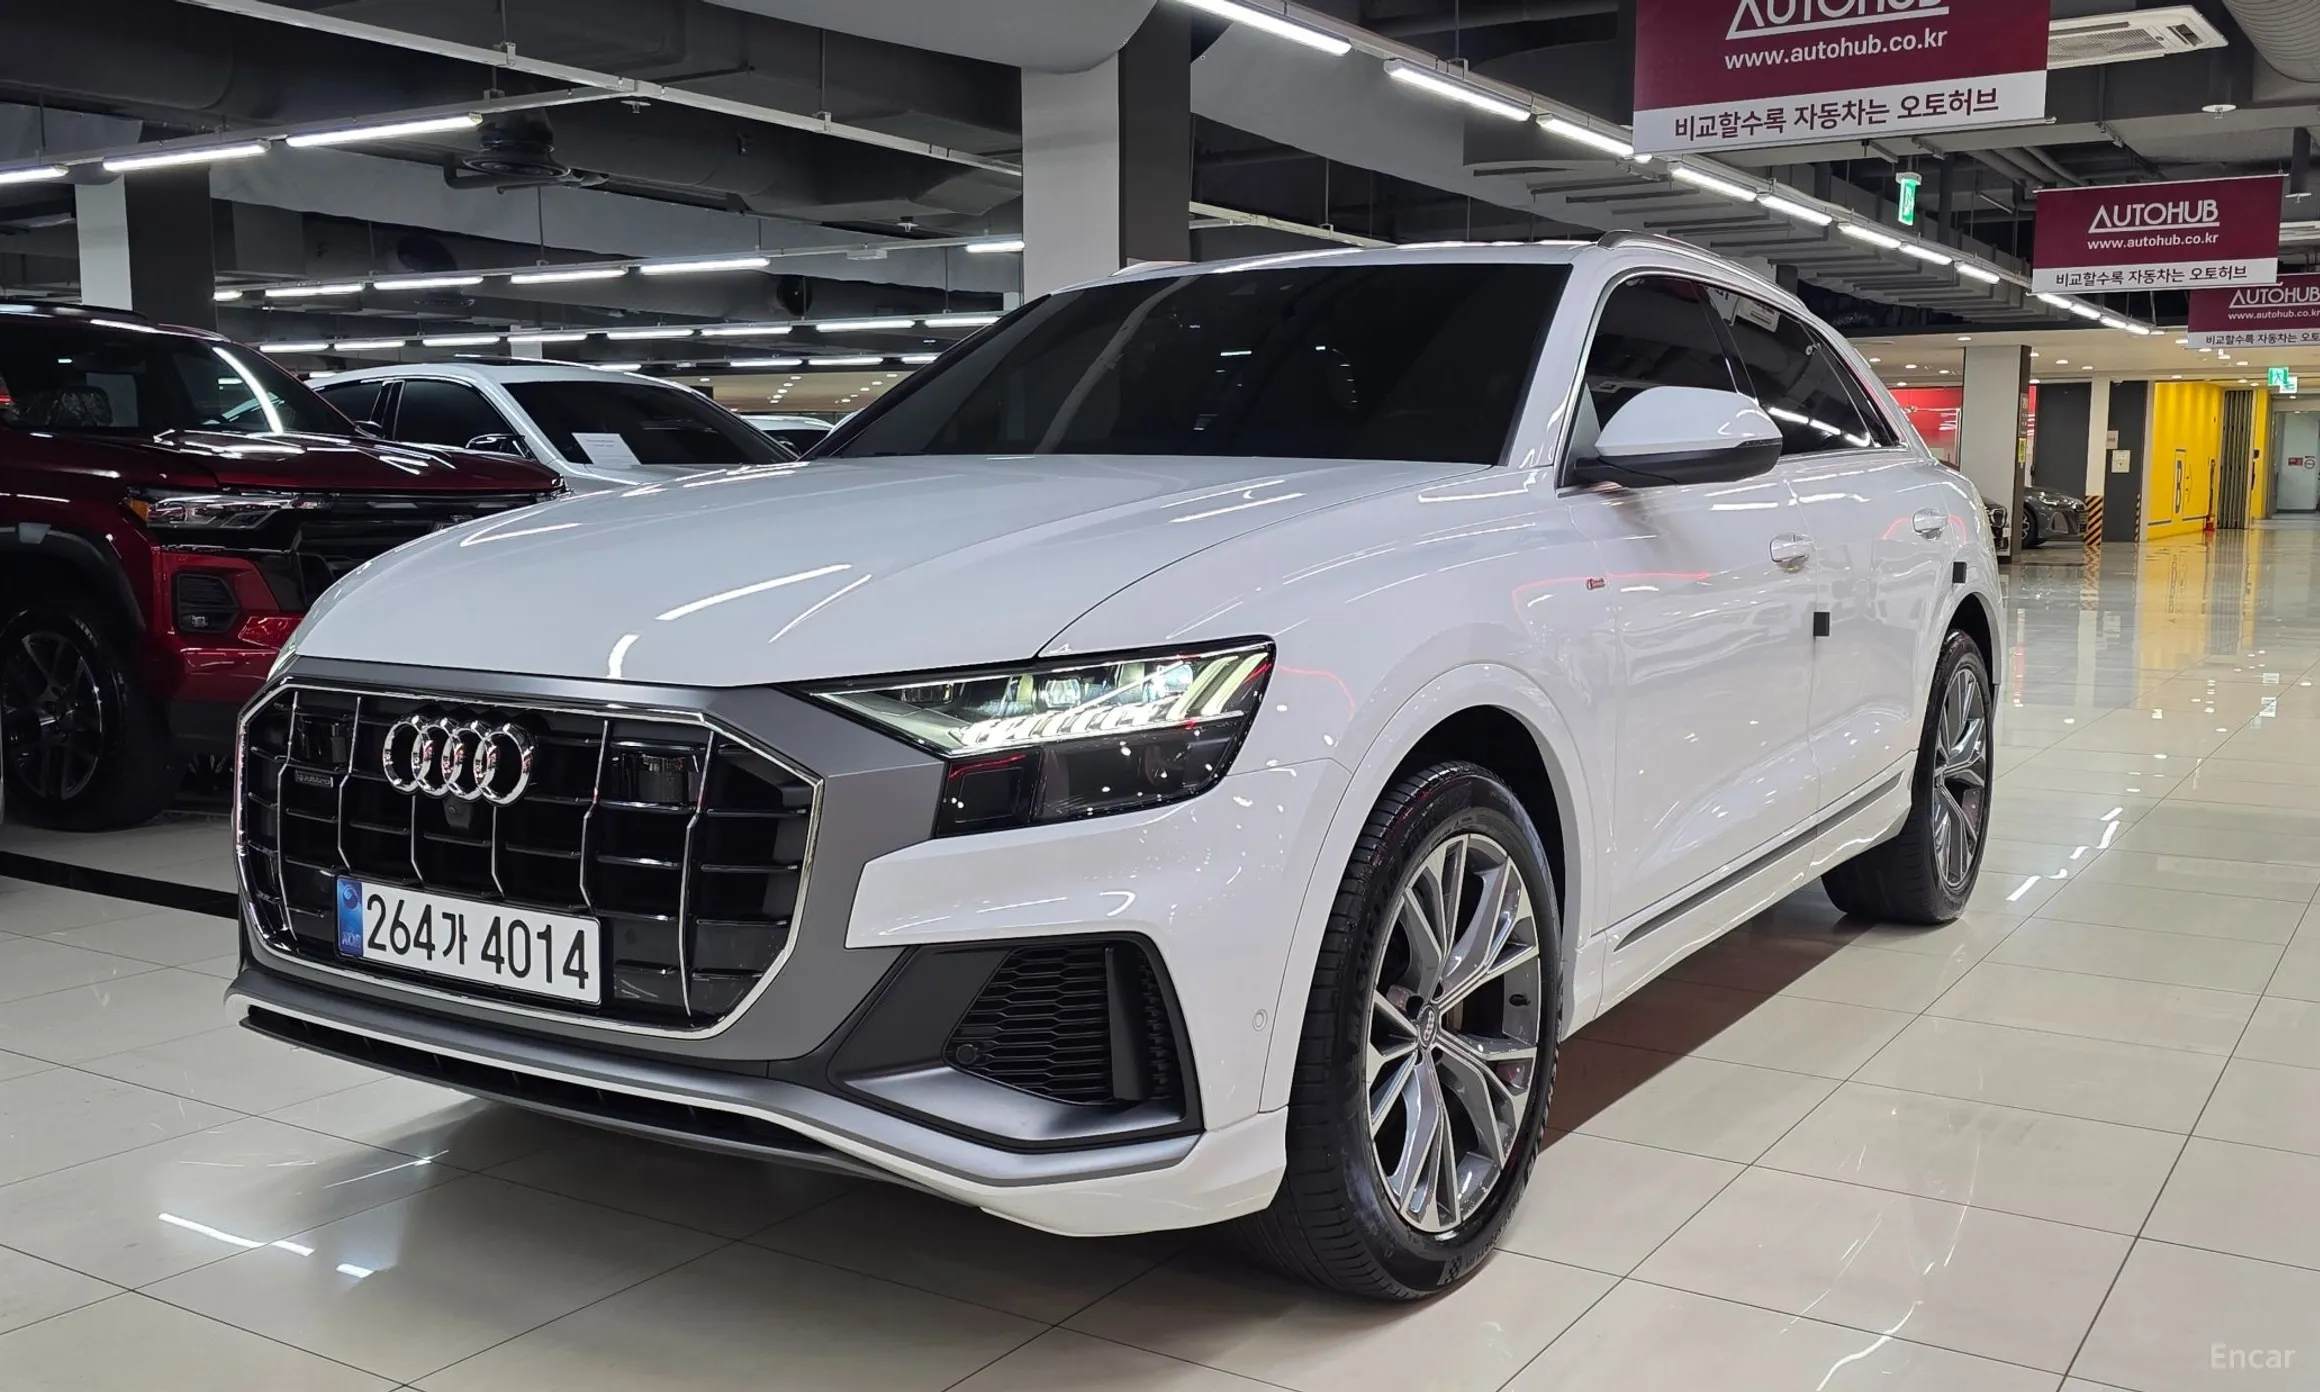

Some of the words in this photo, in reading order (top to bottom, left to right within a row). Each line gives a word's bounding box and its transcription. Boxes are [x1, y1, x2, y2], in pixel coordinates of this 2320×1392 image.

[1725, 28, 1948, 70] www.autohub.co.kr
[1675, 107, 1787, 141] 비교할수록
[1794, 99, 1890, 131] 자동차는
[1897, 88, 1999, 120] 오토허브
[2088, 199, 2220, 234] AUTOHUB
[2088, 232, 2219, 250] www.autohub.co.kr
[2056, 271, 2123, 287] 비교할수록
[2128, 268, 2185, 284] 자동차는
[2189, 265, 2248, 280] 오토허브
[2229, 286, 2320, 309] AUTOHUB
[2206, 334, 2254, 345] 비교할수록
[2257, 333, 2297, 343] 자동차는
[367, 893, 468, 965] 264가
[480, 916, 589, 989] 4014
